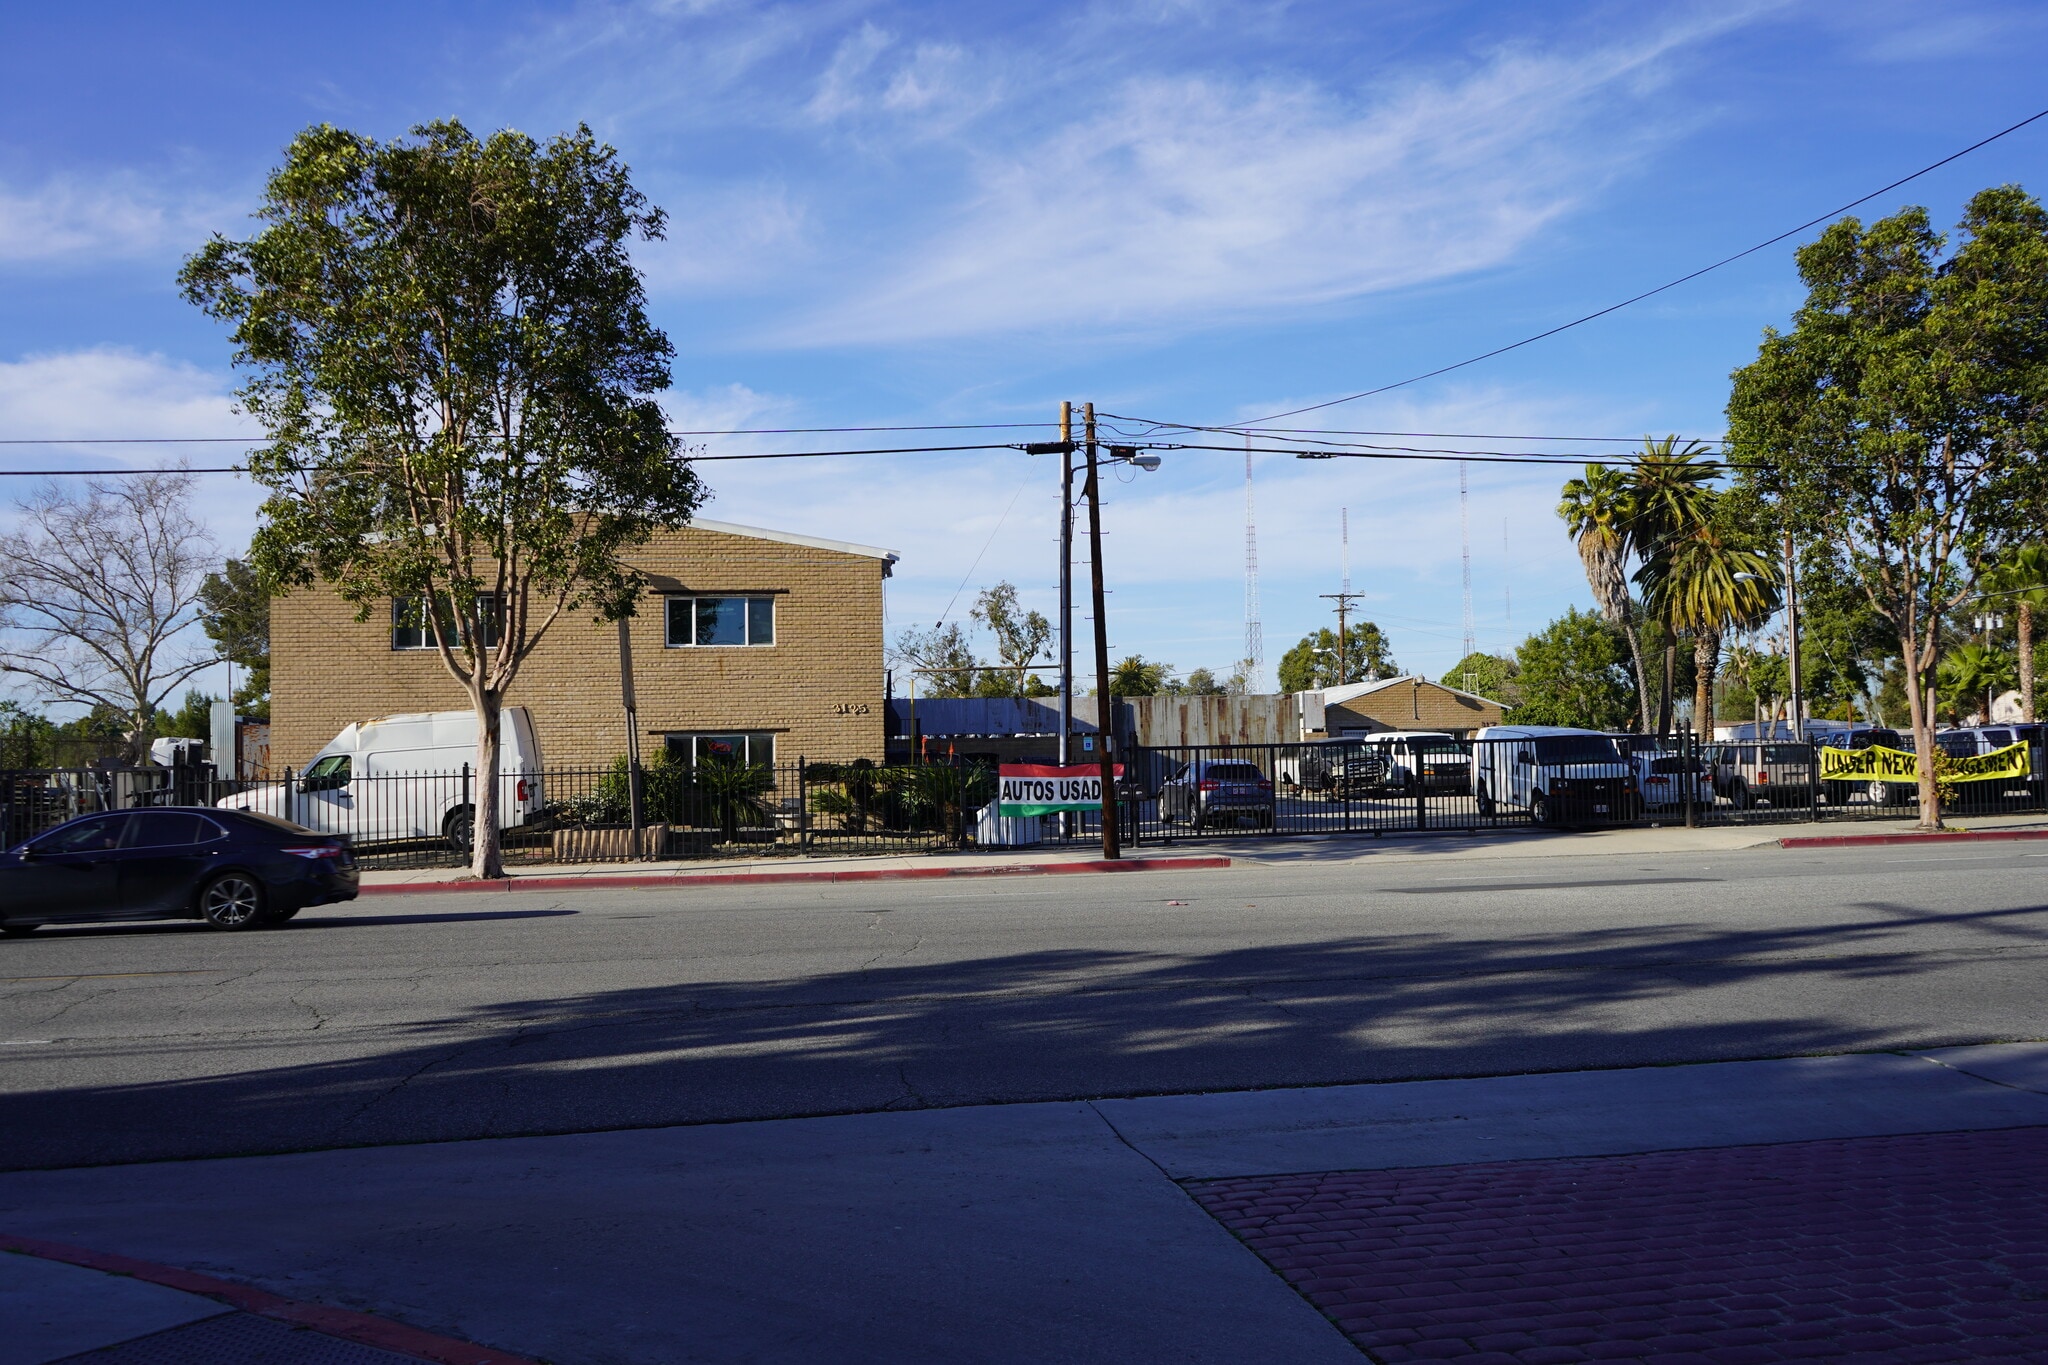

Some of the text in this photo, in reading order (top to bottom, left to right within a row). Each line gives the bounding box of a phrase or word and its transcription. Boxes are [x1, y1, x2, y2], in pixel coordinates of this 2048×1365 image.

[1824, 750, 1875, 774] UNDER
[1882, 751, 1917, 775] NEW
[1002, 780, 1054, 801] AUTOS
